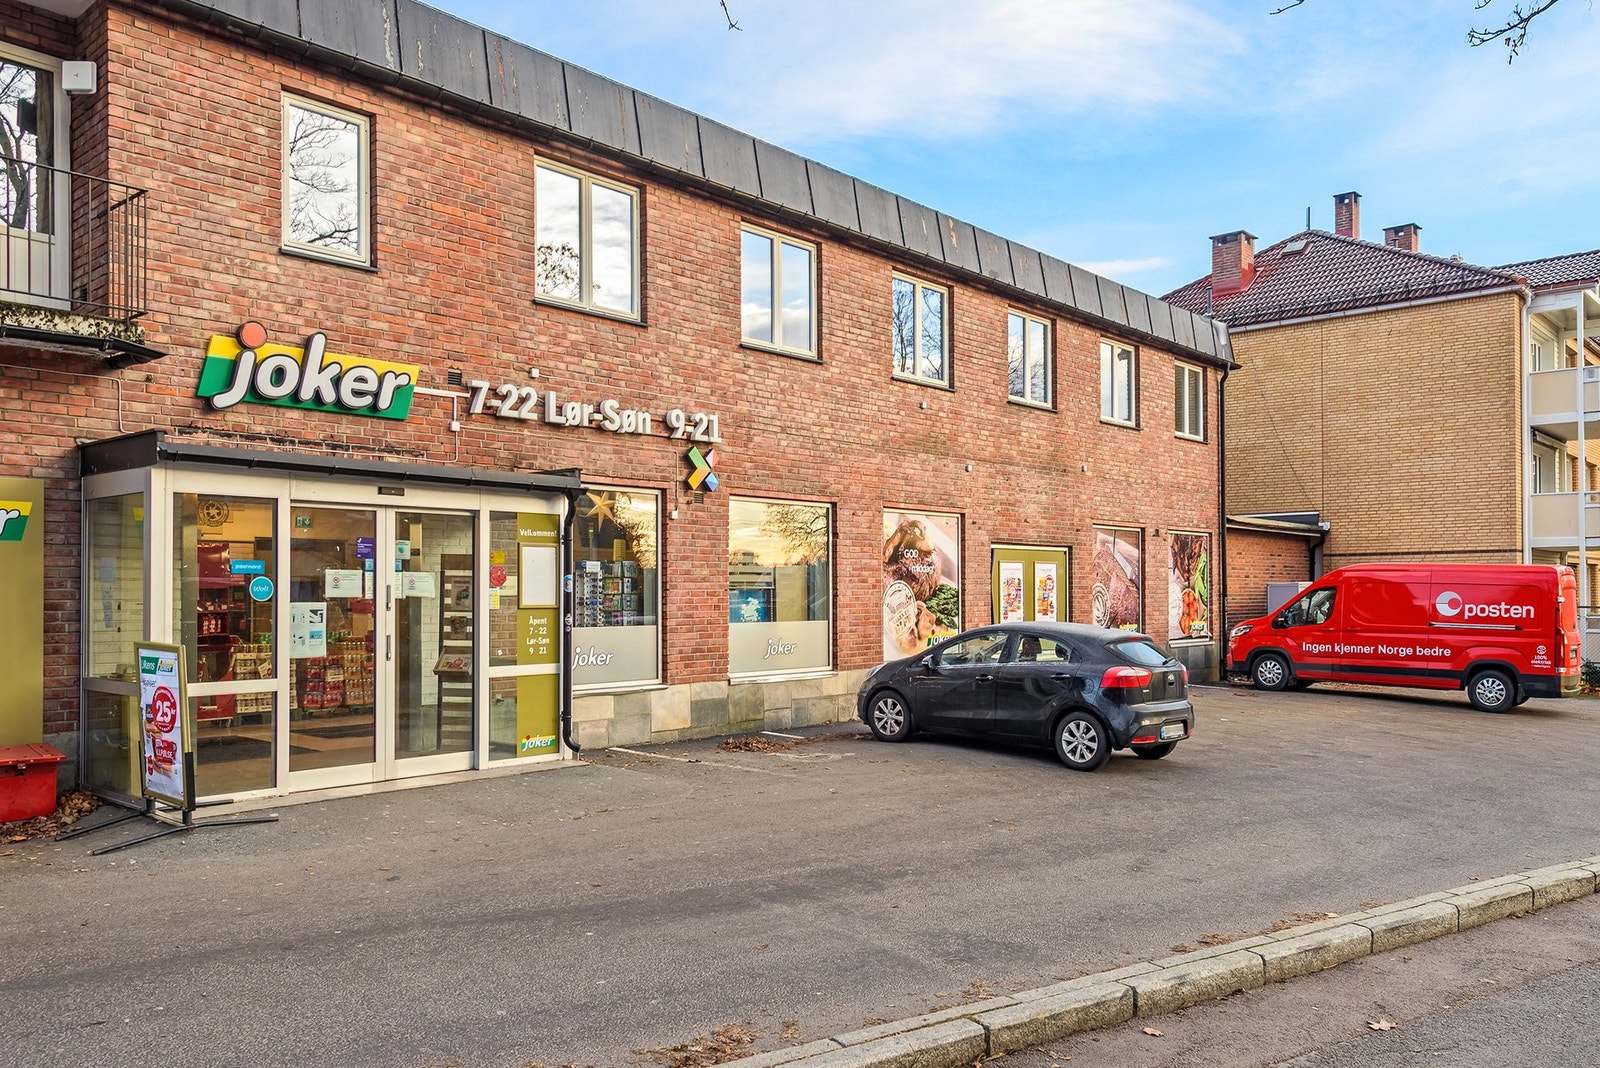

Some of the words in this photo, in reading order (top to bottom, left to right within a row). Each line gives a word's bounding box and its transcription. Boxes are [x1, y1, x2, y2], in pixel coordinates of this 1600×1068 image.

[211, 321, 411, 410] joker
[468, 380, 538, 420] 7-22
[544, 391, 652, 434] Lør-Søn
[666, 408, 723, 443] 9-21
[903, 549, 919, 559] GOD
[253, 584, 270, 592] Wolt
[1464, 601, 1535, 620] posten
[928, 629, 956, 647] joke
[572, 646, 614, 671] joker
[764, 638, 797, 660] joker
[1302, 641, 1332, 653] Ingen
[1334, 642, 1375, 655] kjenner
[1378, 644, 1413, 657] Norge
[1416, 645, 1451, 656] bedre
[155, 700, 171, 723] 25
[521, 734, 556, 752] joker
